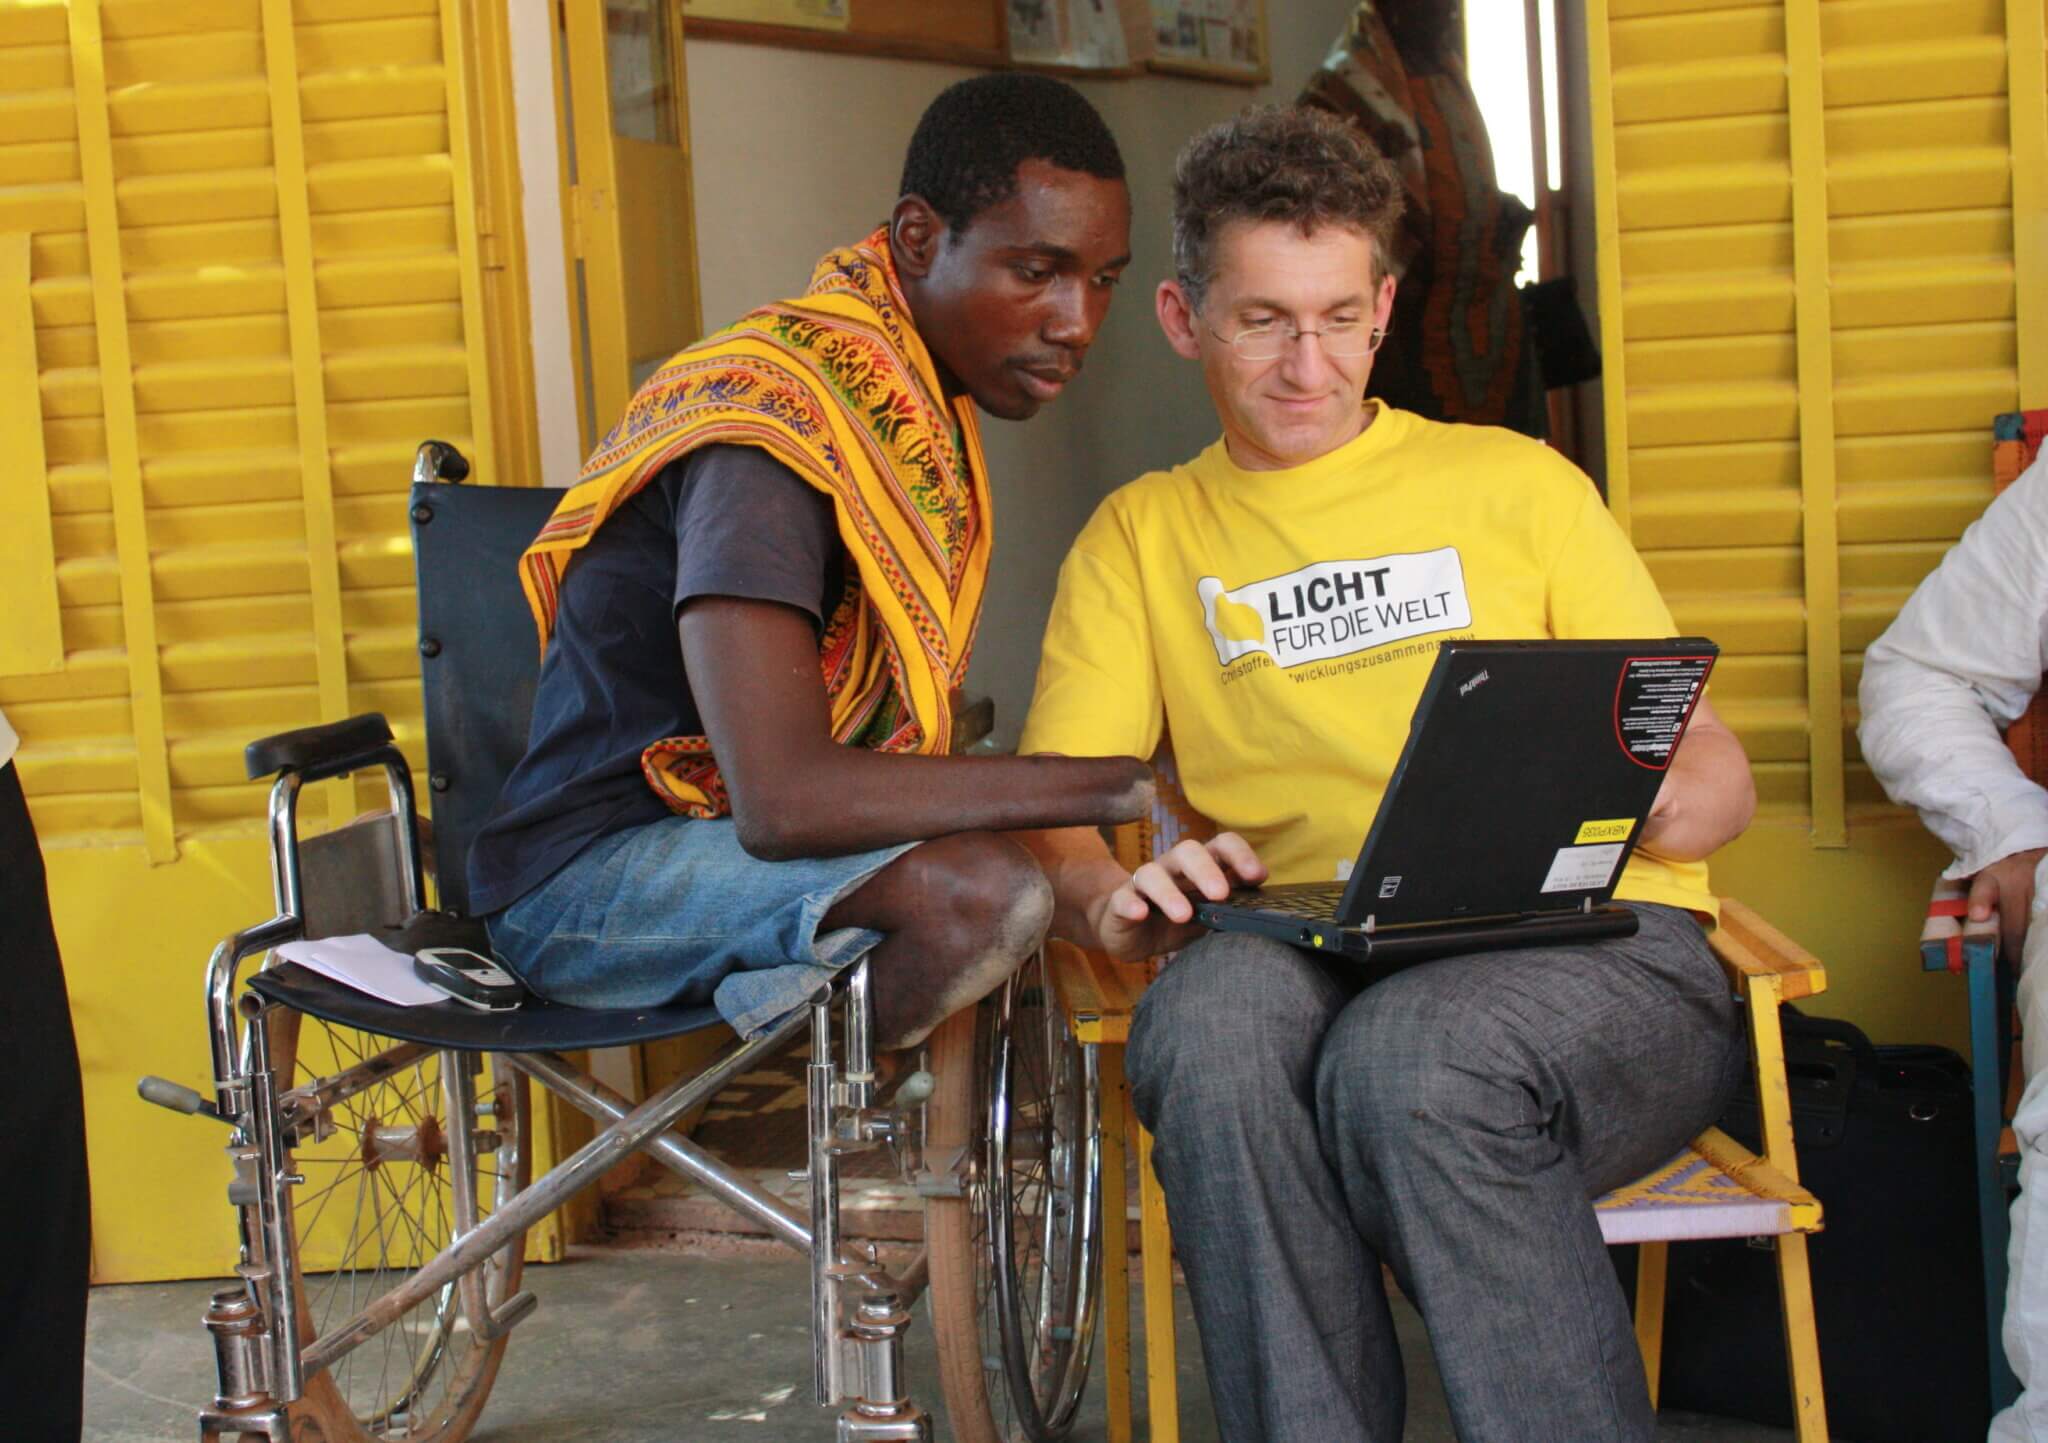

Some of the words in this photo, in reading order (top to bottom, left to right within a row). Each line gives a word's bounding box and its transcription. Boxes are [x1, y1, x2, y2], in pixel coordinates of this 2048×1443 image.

[1268, 567, 1390, 623] LICHT
[1273, 621, 1326, 655] FÜR
[1331, 606, 1373, 643] DIE
[1375, 591, 1452, 629] WELT
